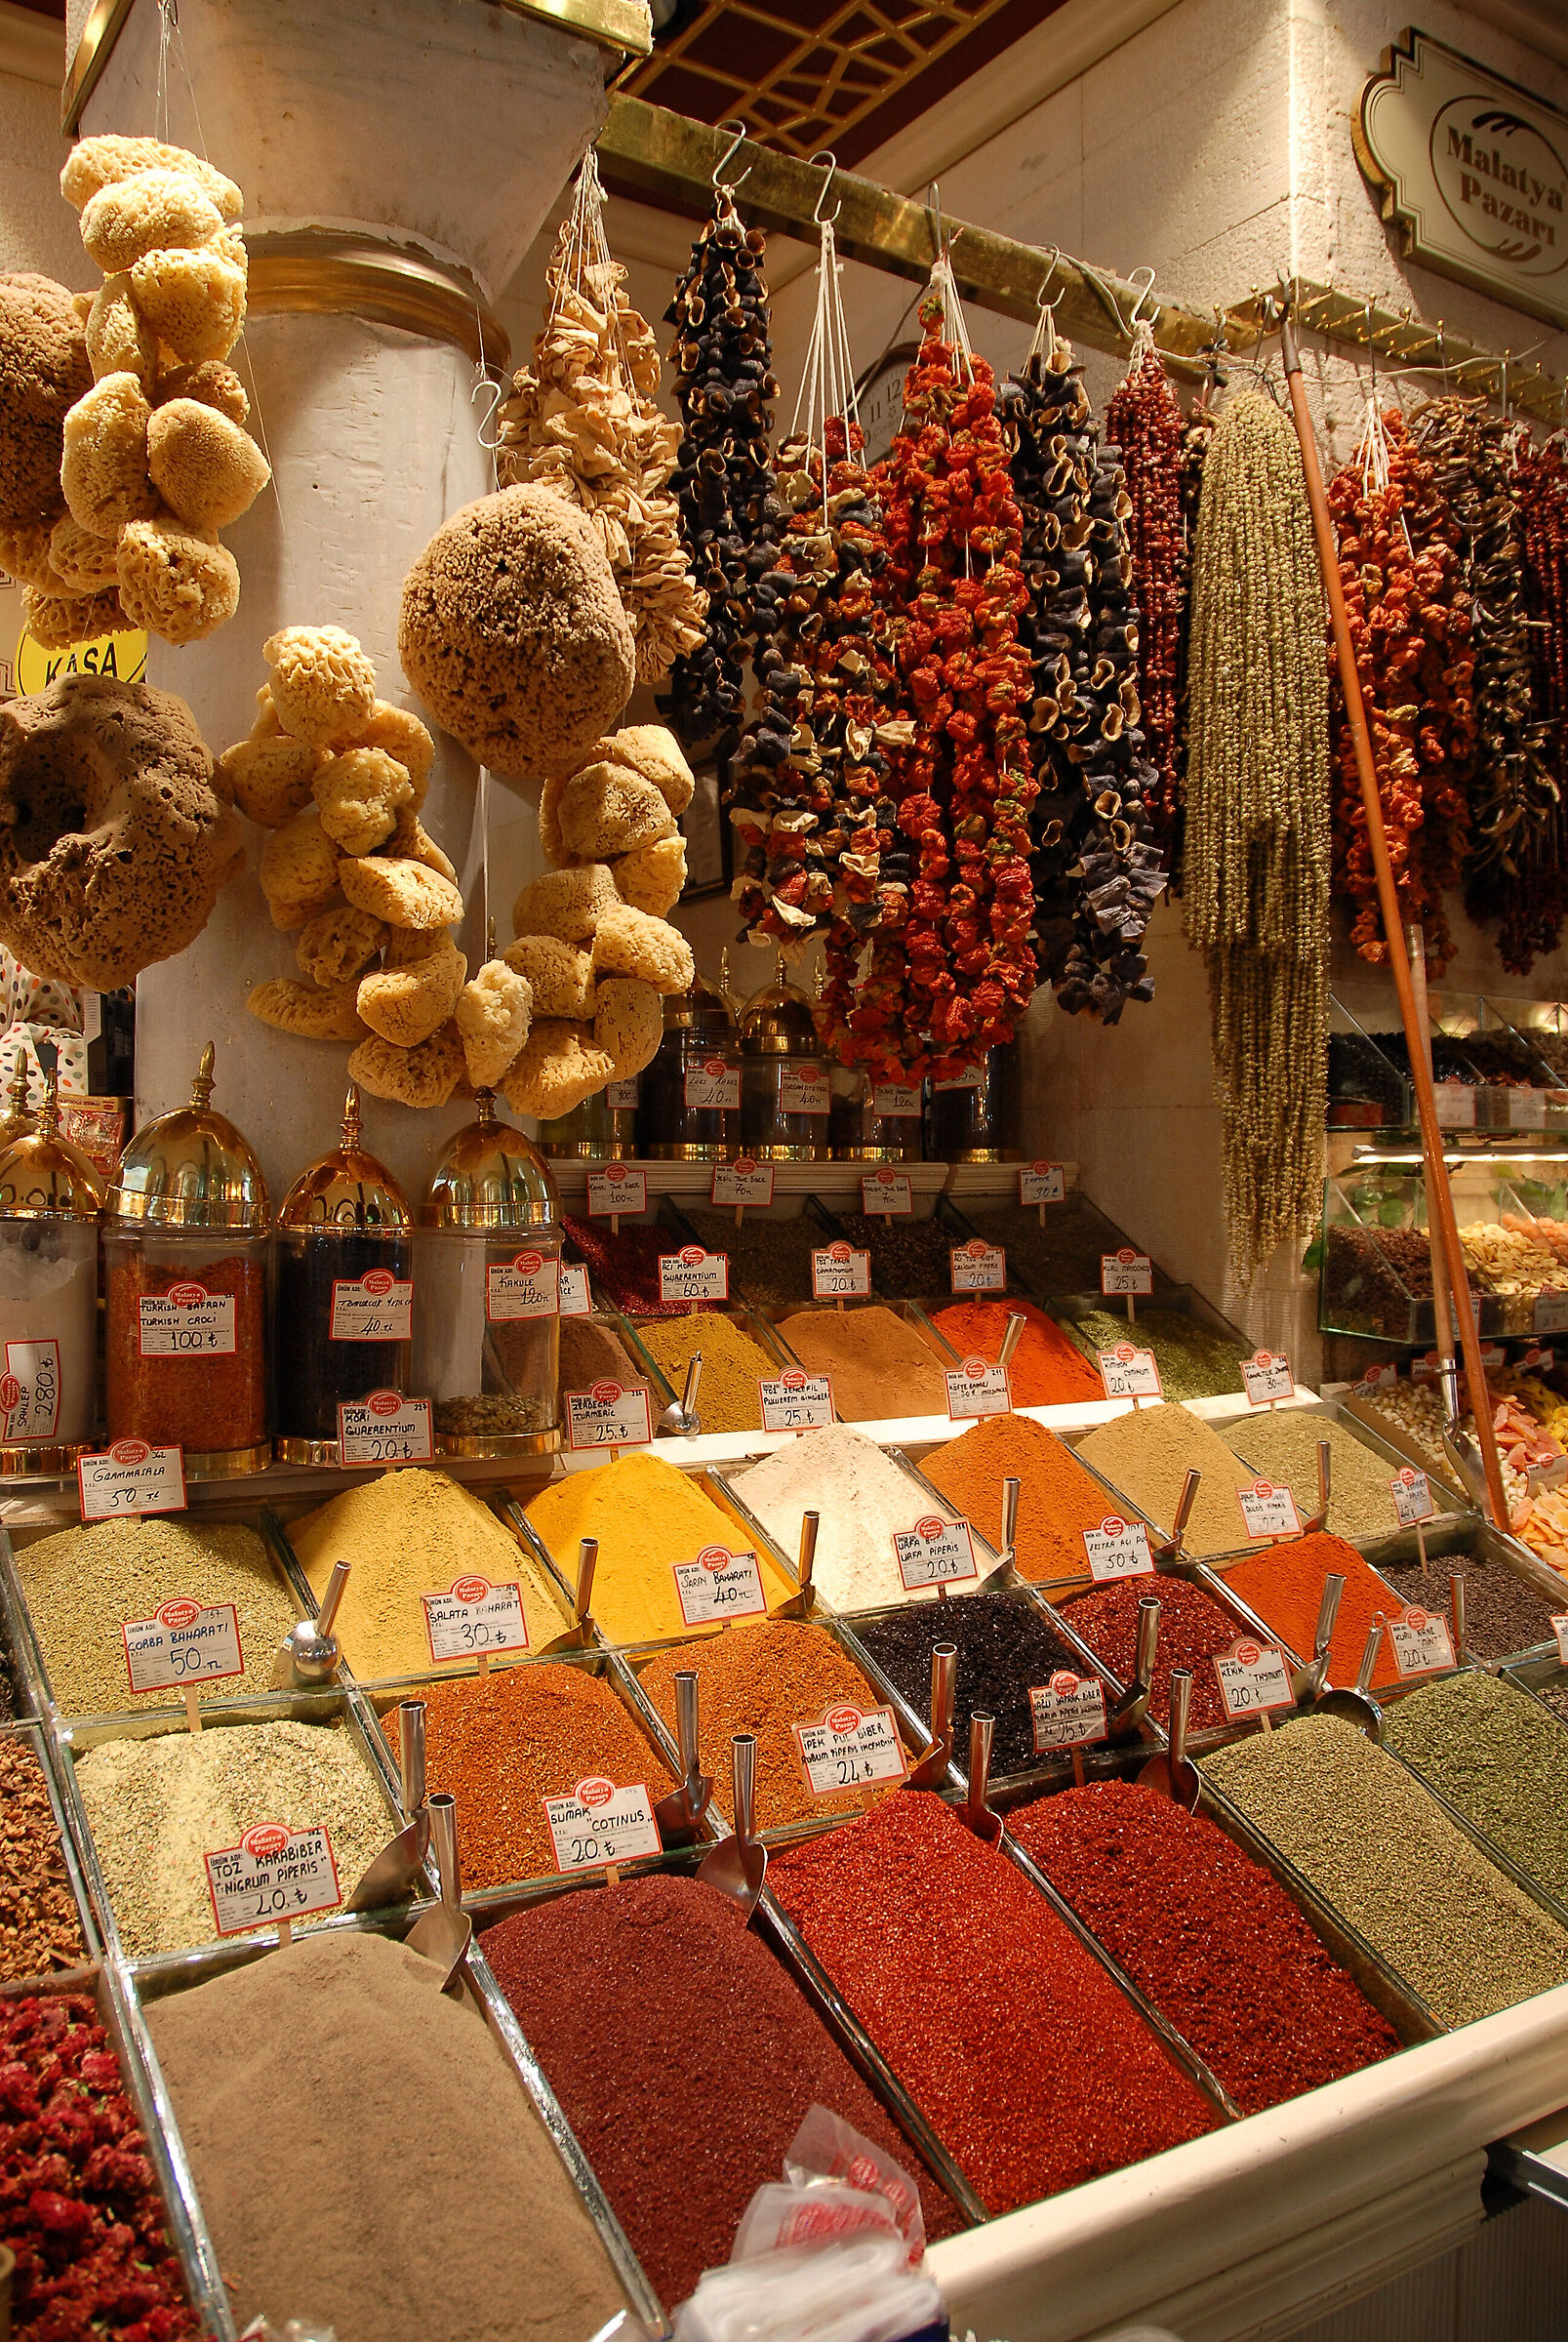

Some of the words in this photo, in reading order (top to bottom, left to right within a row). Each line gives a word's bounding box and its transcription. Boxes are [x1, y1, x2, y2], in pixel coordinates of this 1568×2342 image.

[1447, 125, 1565, 213] Malatya
[1461, 171, 1555, 246] Pazarı
[888, 379, 901, 402] 12
[870, 401, 881, 423] 11
[45, 642, 118, 688] KASA
[18, 1386, 30, 1427] SAHLEP
[110, 1487, 137, 1507] 50
[901, 1551, 922, 1561] URFA
[1106, 1553, 1125, 1569] 50
[168, 1615, 192, 1624] Pazarı
[429, 1609, 468, 1623] SALATA
[170, 1622, 228, 1643] BAHARATI
[835, 1721, 857, 1730] Pazarı
[550, 1806, 591, 1824] SUMAK
[210, 1856, 228, 1867] ÜRÜN
[214, 1862, 243, 1878] TOZ
